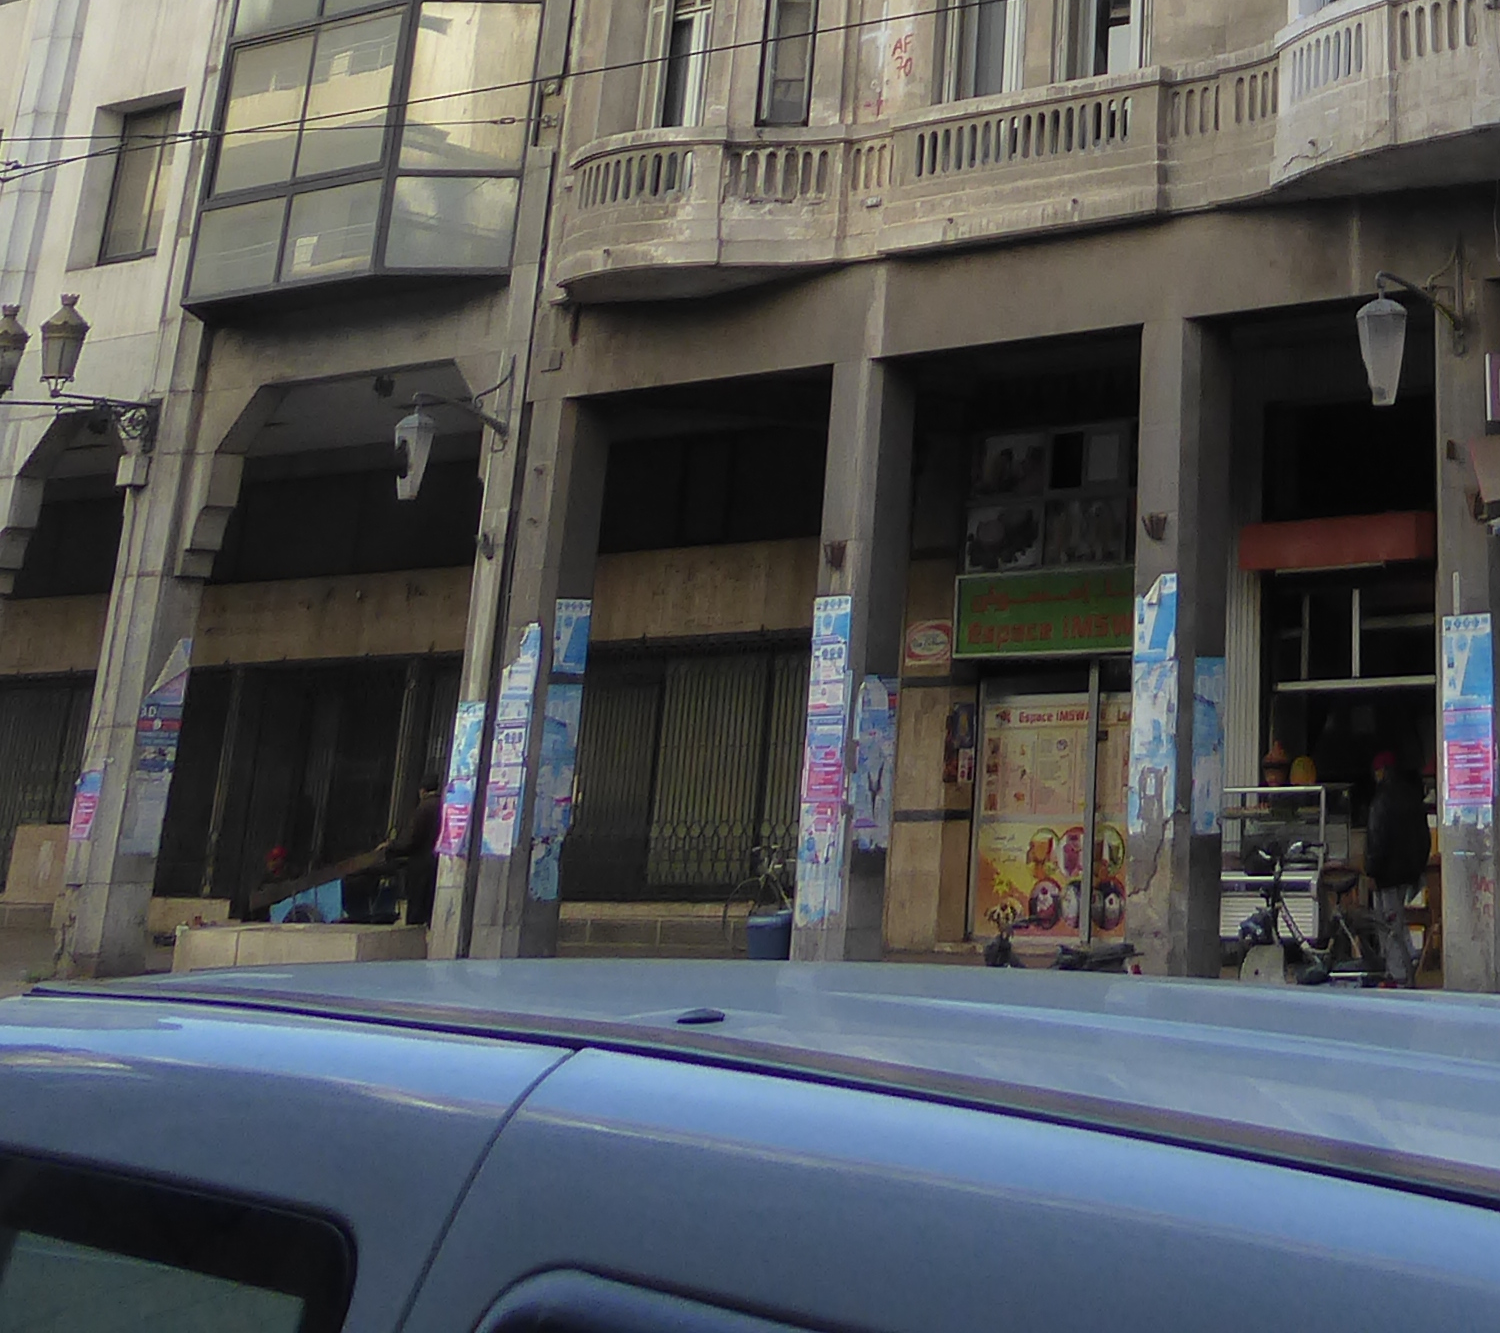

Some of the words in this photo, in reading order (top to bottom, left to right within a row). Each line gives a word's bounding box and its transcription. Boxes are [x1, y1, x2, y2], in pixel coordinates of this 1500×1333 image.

[891, 33, 914, 57] AF
[967, 621, 1053, 649] Espace
[1018, 711, 1054, 724] Espace
